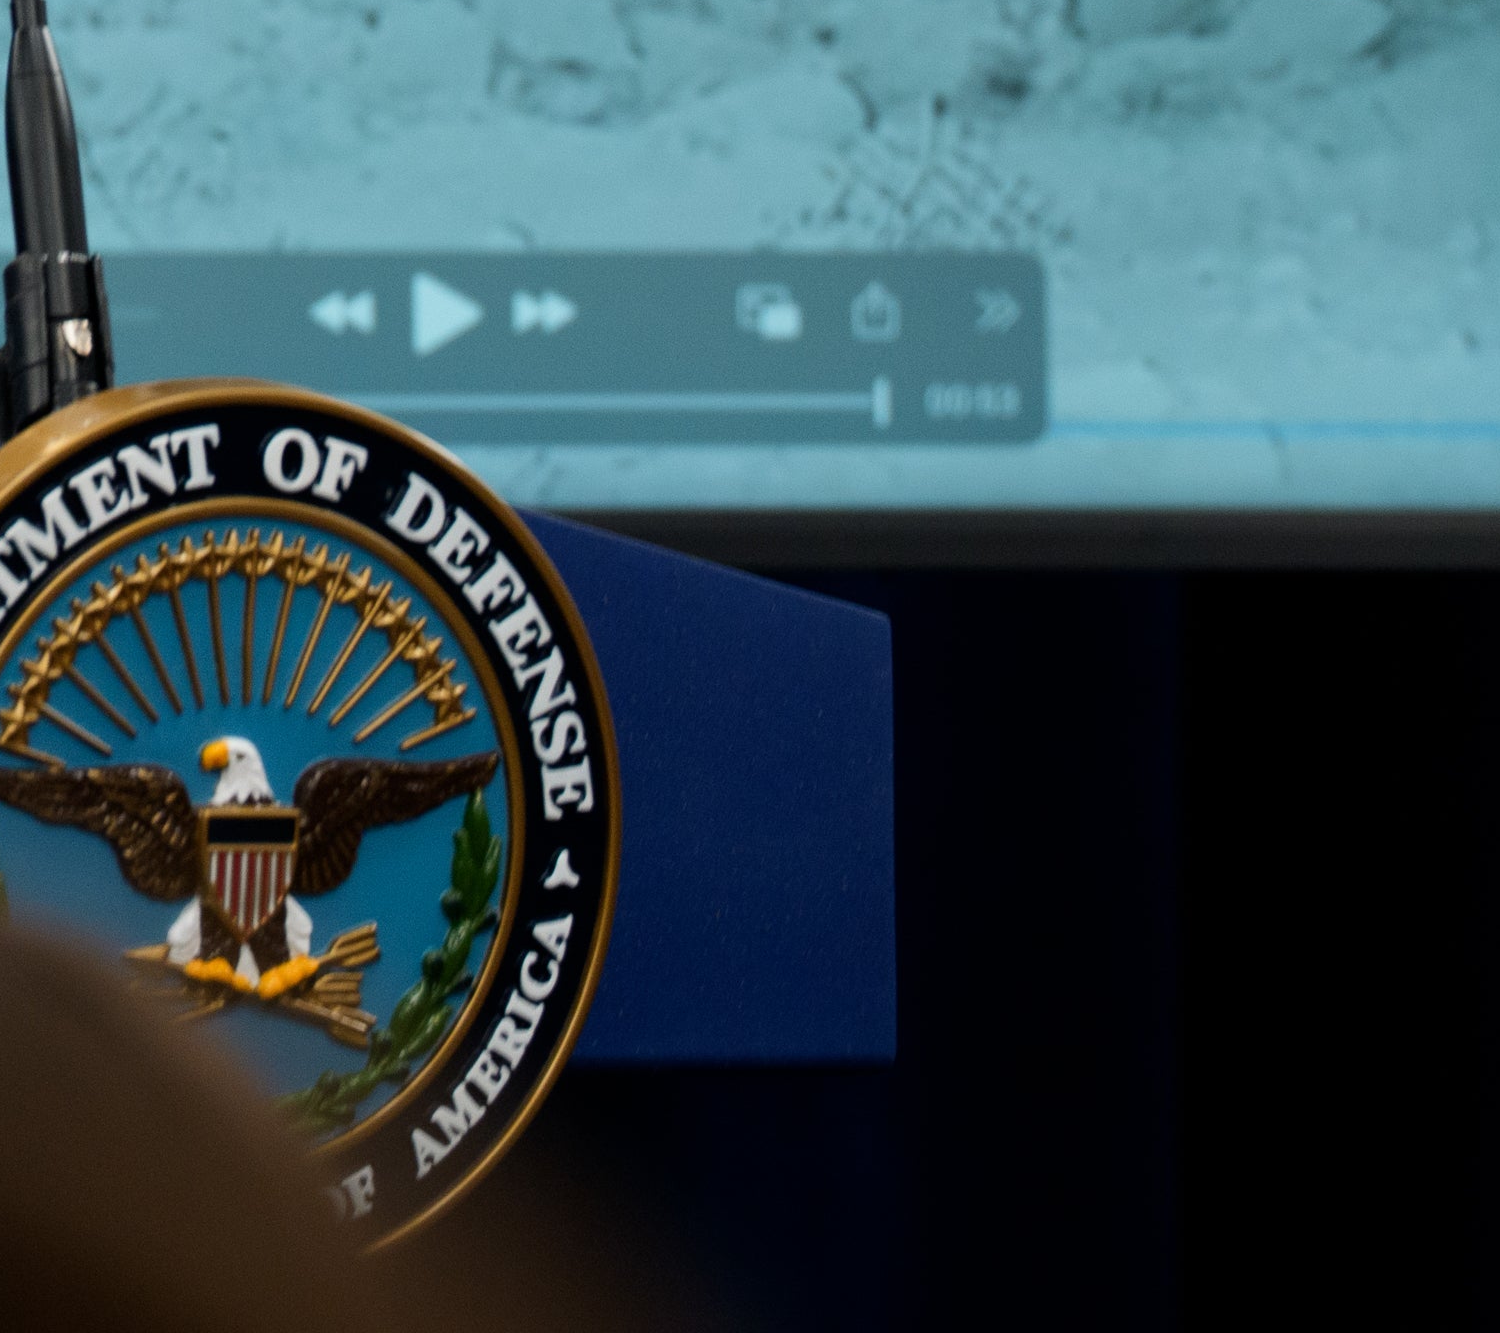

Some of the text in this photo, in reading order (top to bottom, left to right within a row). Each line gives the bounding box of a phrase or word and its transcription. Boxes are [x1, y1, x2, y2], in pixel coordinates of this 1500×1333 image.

[262, 427, 369, 503] OF
[385, 471, 595, 822] DEFENSE
[410, 912, 574, 1181] AMERICA
